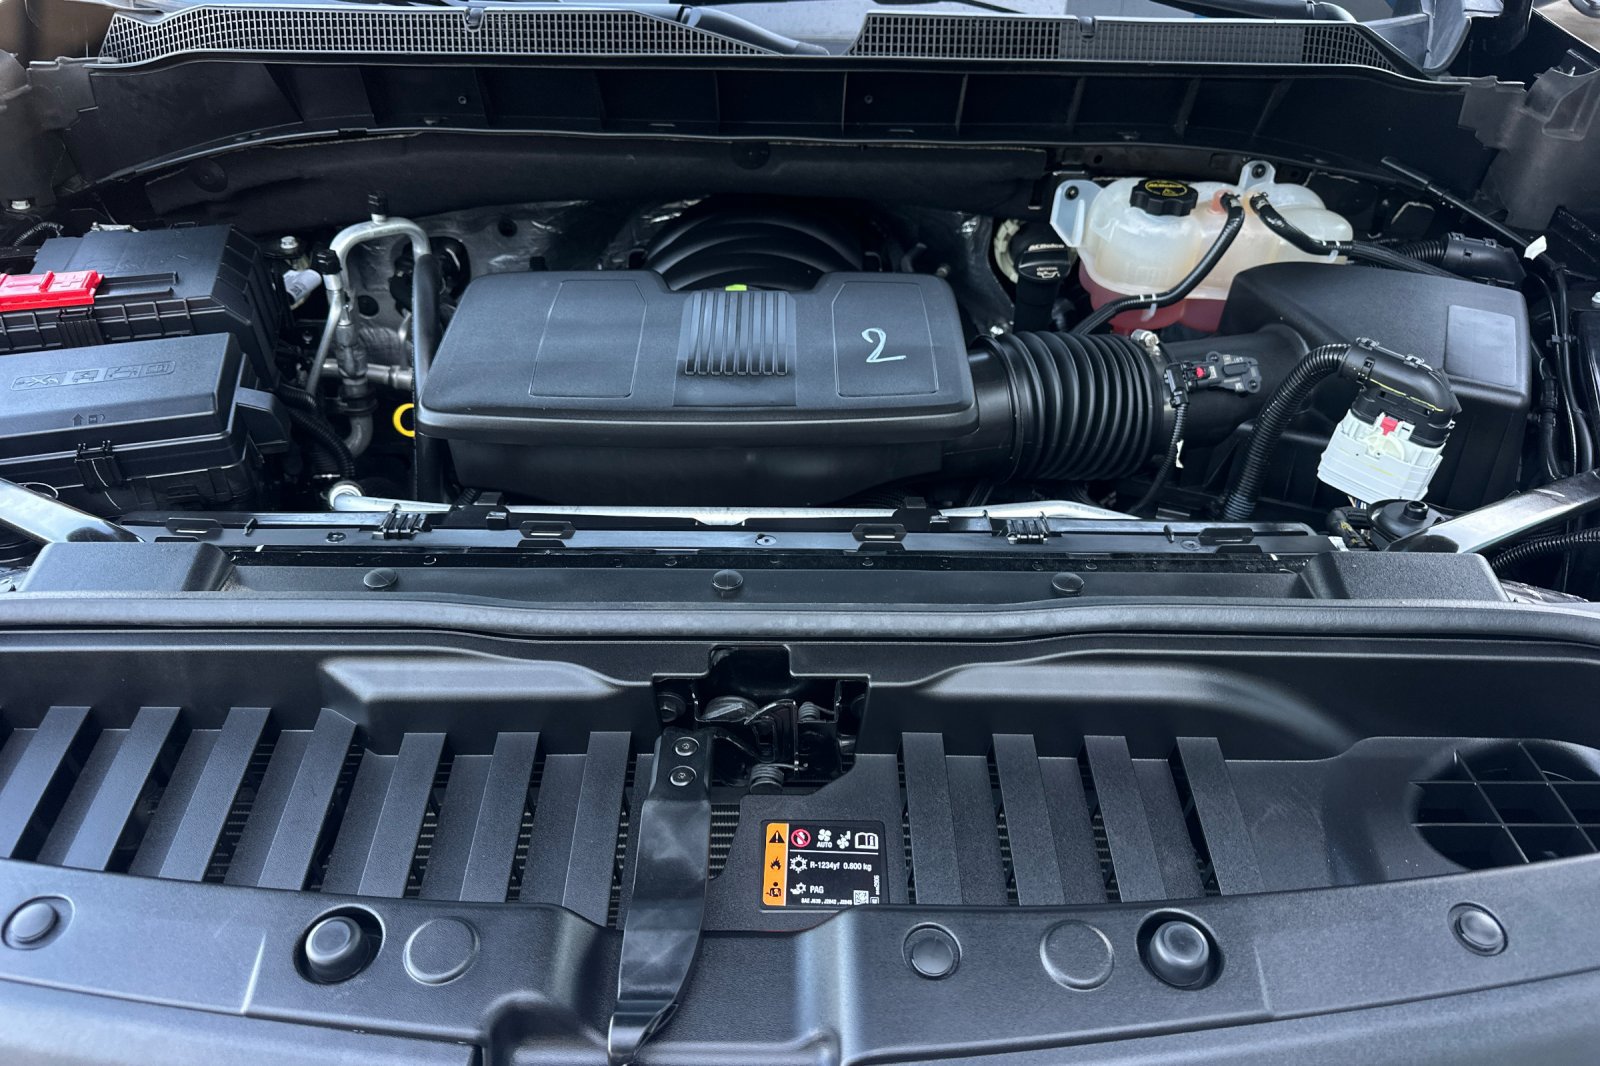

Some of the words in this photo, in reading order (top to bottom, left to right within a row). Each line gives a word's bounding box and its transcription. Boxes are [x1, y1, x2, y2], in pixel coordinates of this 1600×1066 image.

[861, 327, 907, 363] 2
[809, 861, 841, 870] R-1234yf
[863, 862, 872, 872] kg
[809, 885, 825, 894] PAG
